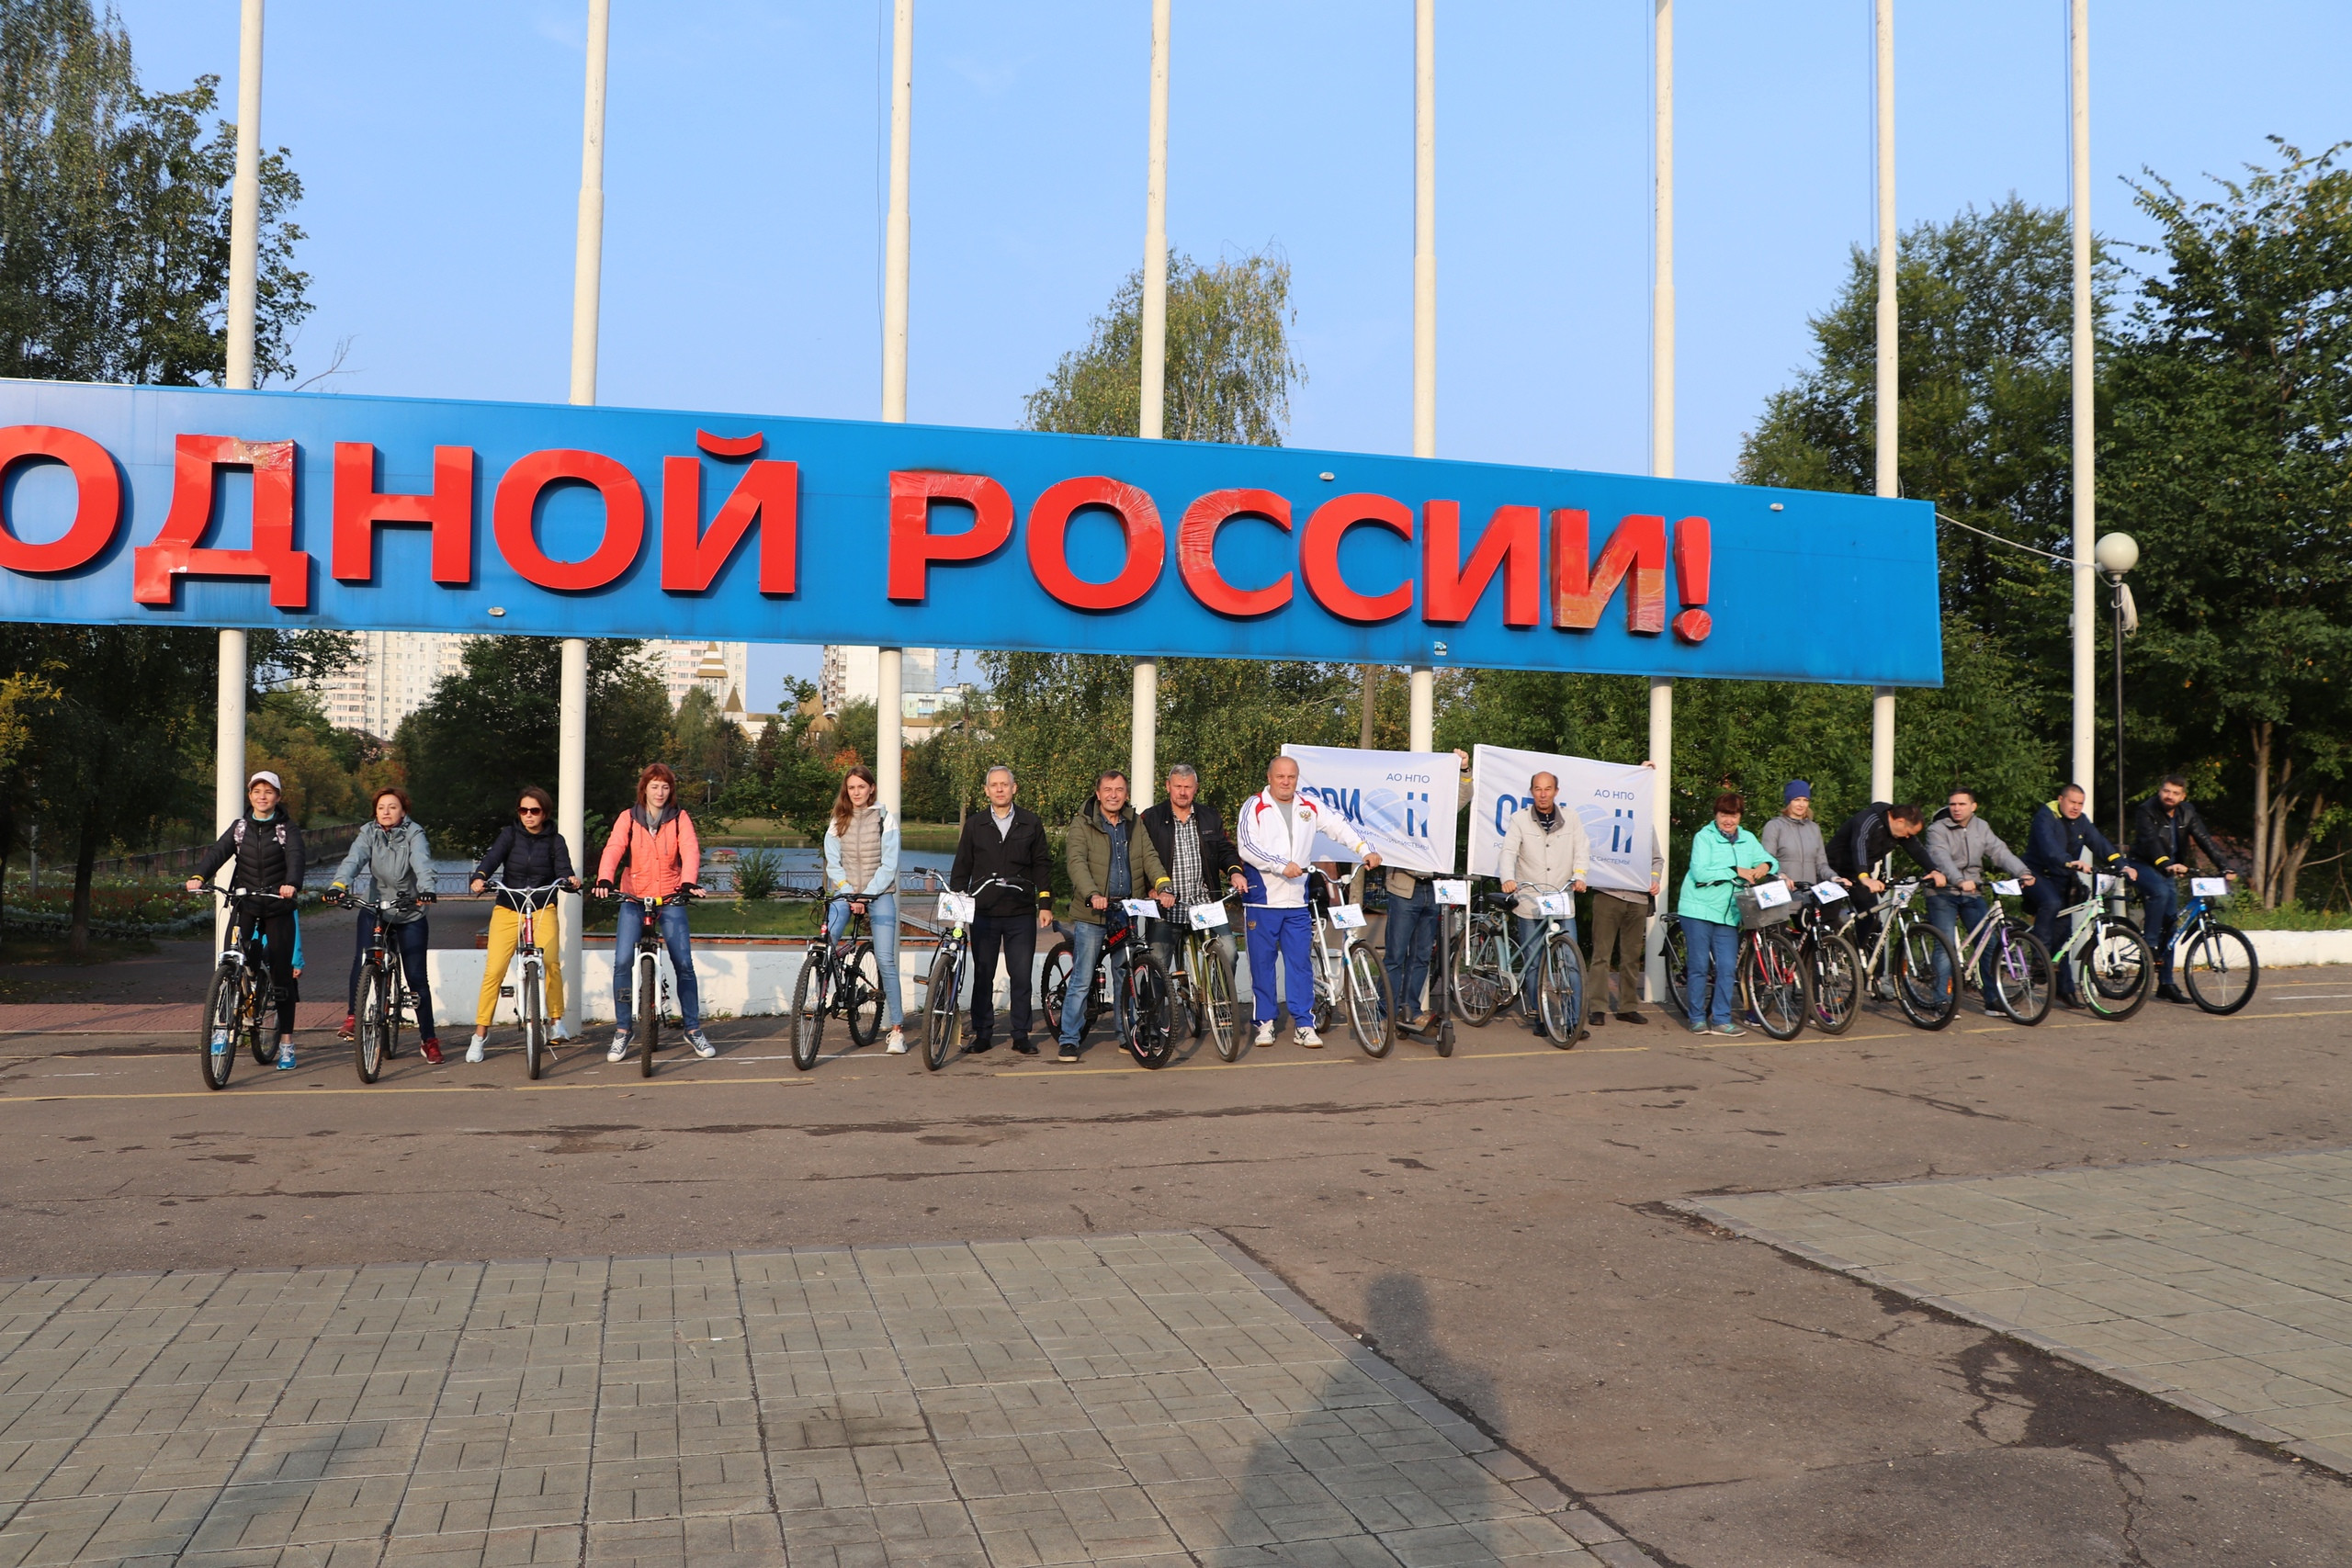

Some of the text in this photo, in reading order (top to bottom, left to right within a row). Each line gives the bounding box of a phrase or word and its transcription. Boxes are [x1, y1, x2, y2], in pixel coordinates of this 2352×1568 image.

[887, 469, 1713, 644] РОССИИ!
[1385, 773, 1430, 784] АО НПО
[1594, 788, 1635, 801] АО НПО
